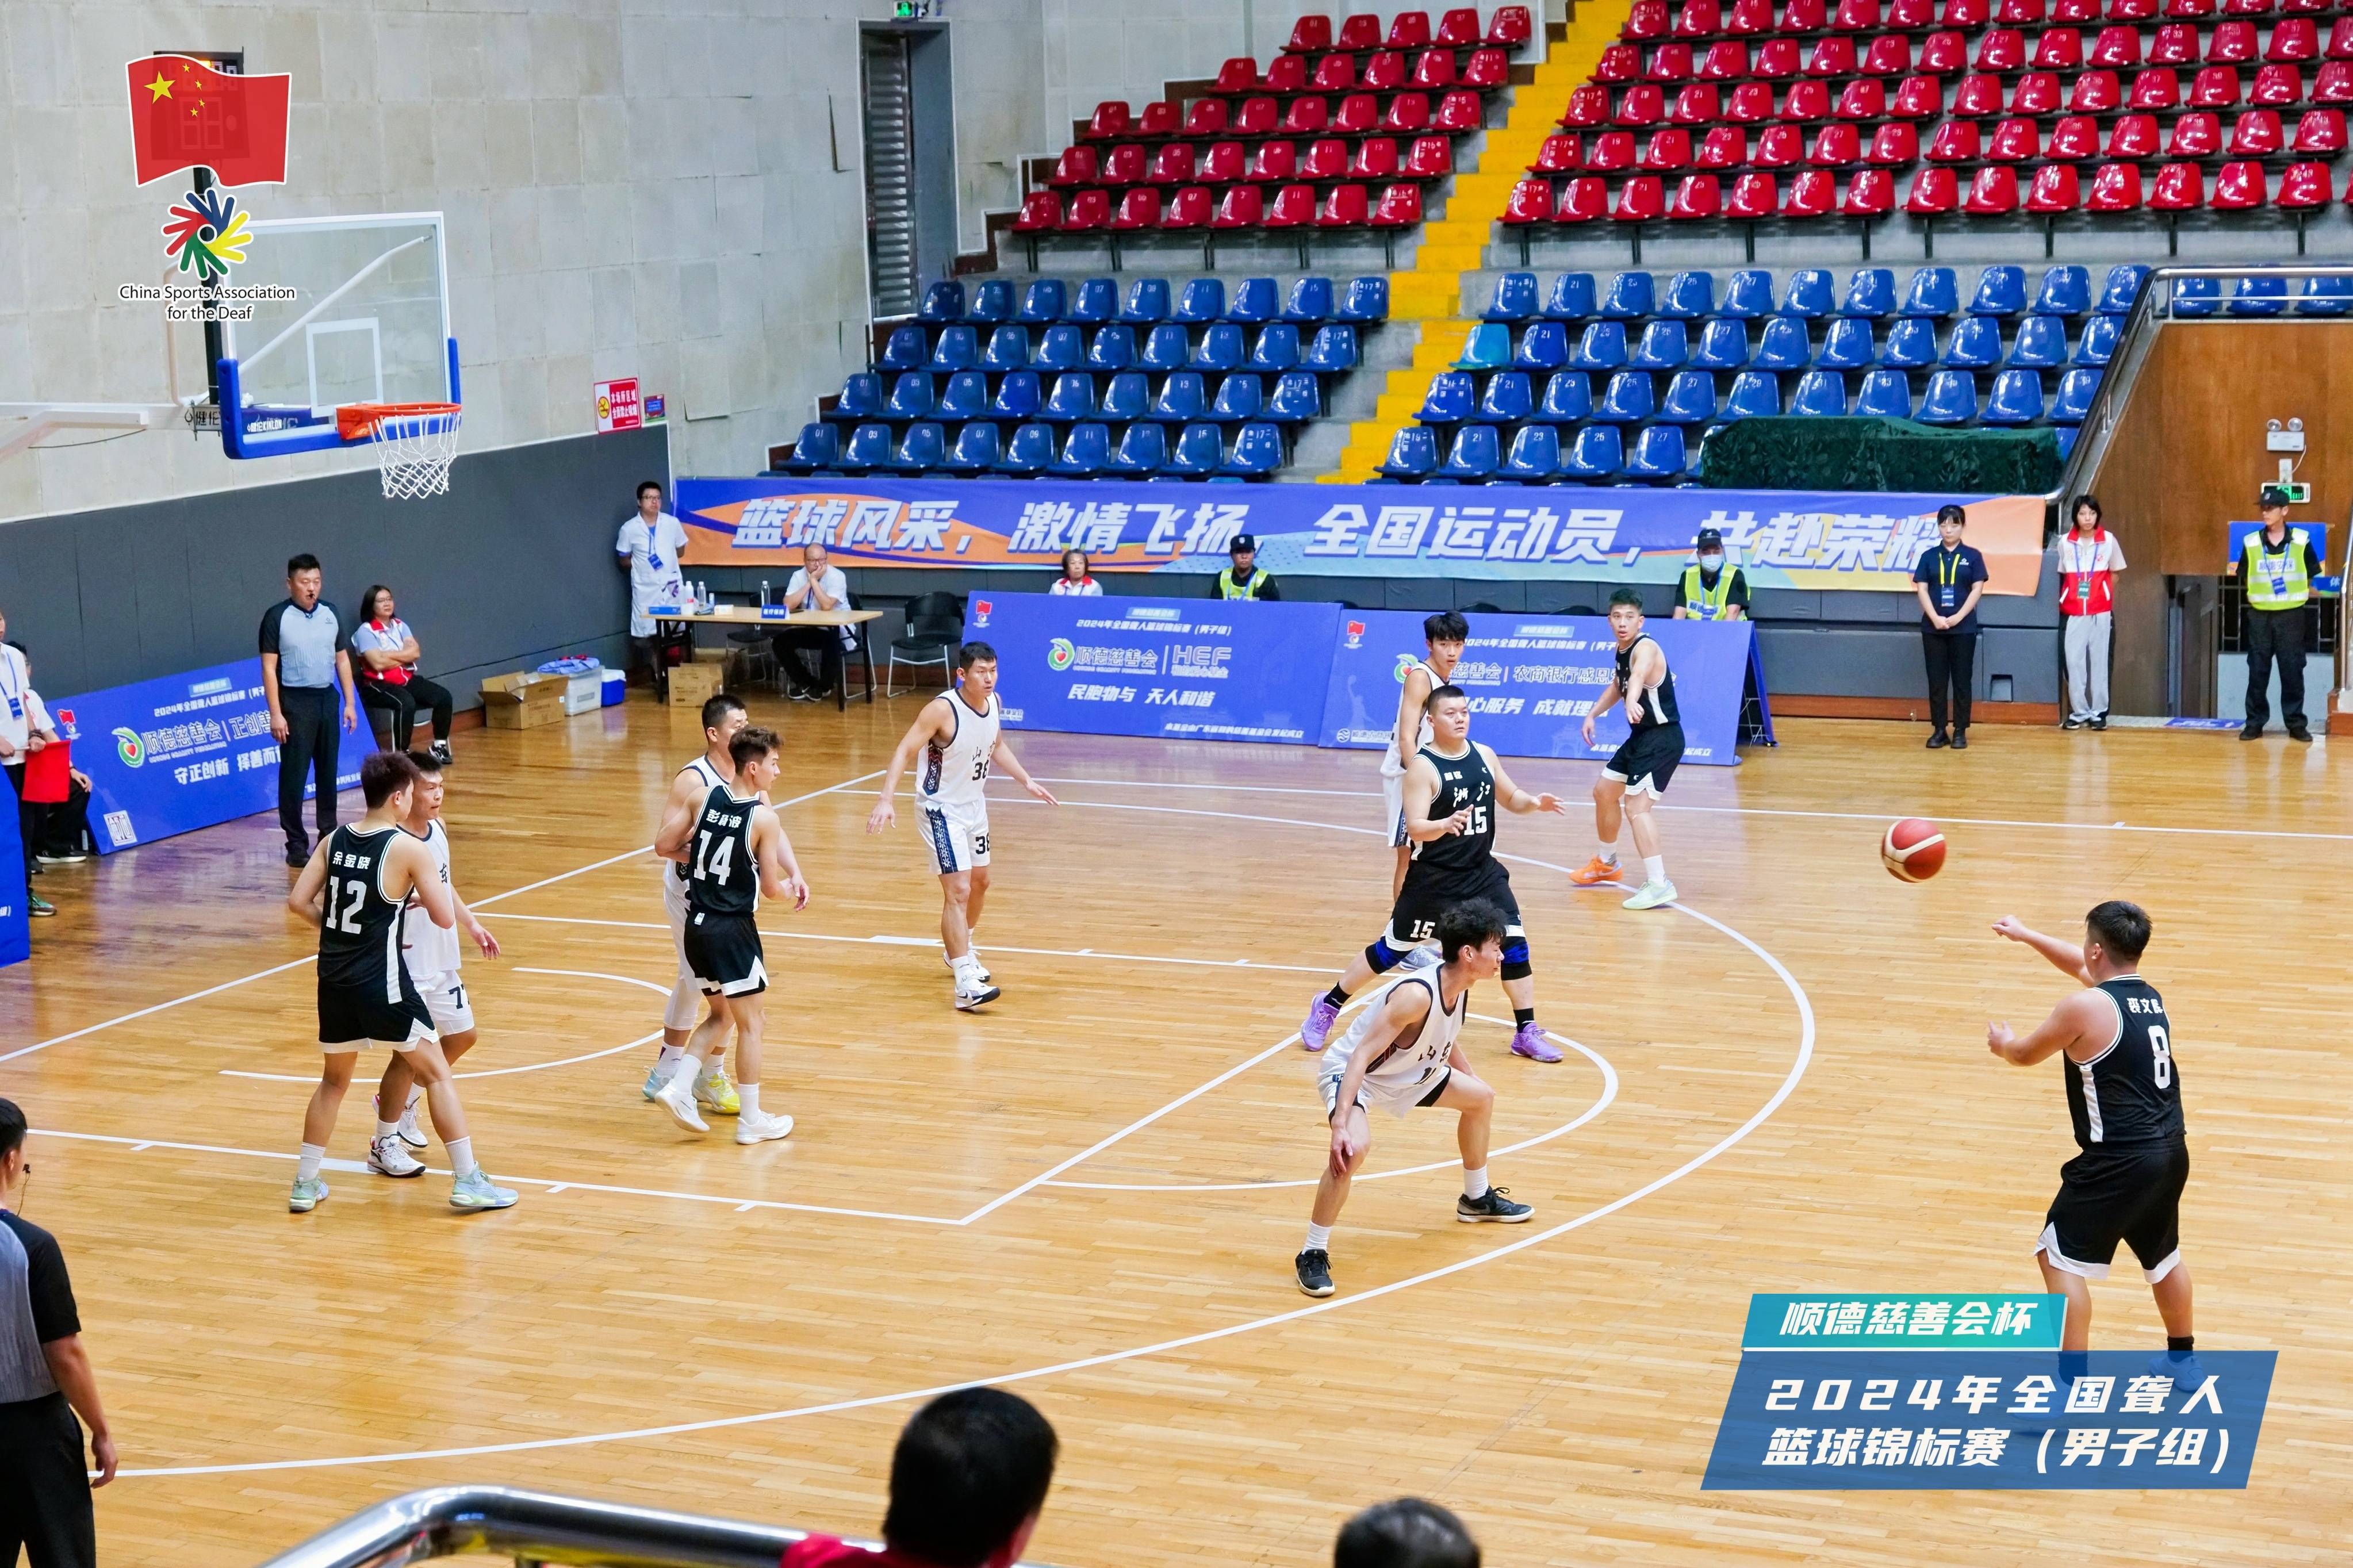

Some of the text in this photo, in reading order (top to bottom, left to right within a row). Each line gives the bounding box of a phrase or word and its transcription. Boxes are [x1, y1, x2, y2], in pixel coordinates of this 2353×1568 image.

[1586, 91, 1595, 100] 17
[1570, 281, 1579, 289] 21
[1541, 330, 1550, 339] 21
[1505, 380, 1514, 388] 21
[1688, 378, 1698, 387] 27
[815, 429, 824, 438] 01
[1085, 431, 1093, 439] 11
[1256, 431, 1265, 439] 17
[1473, 434, 1481, 442] 21
[1074, 646, 1159, 669] 顺德慈善会
[1172, 645, 1232, 666] HEF
[1068, 684, 1216, 707] 民胞物与 天人和谐
[141, 718, 222, 755] 顺德慈善会
[174, 757, 229, 785] 守正创新
[1464, 806, 1488, 835] 15
[693, 829, 735, 886] 14
[326, 876, 367, 934] 12
[1410, 919, 1435, 939] 15
[2148, 1025, 2171, 1090] 8
